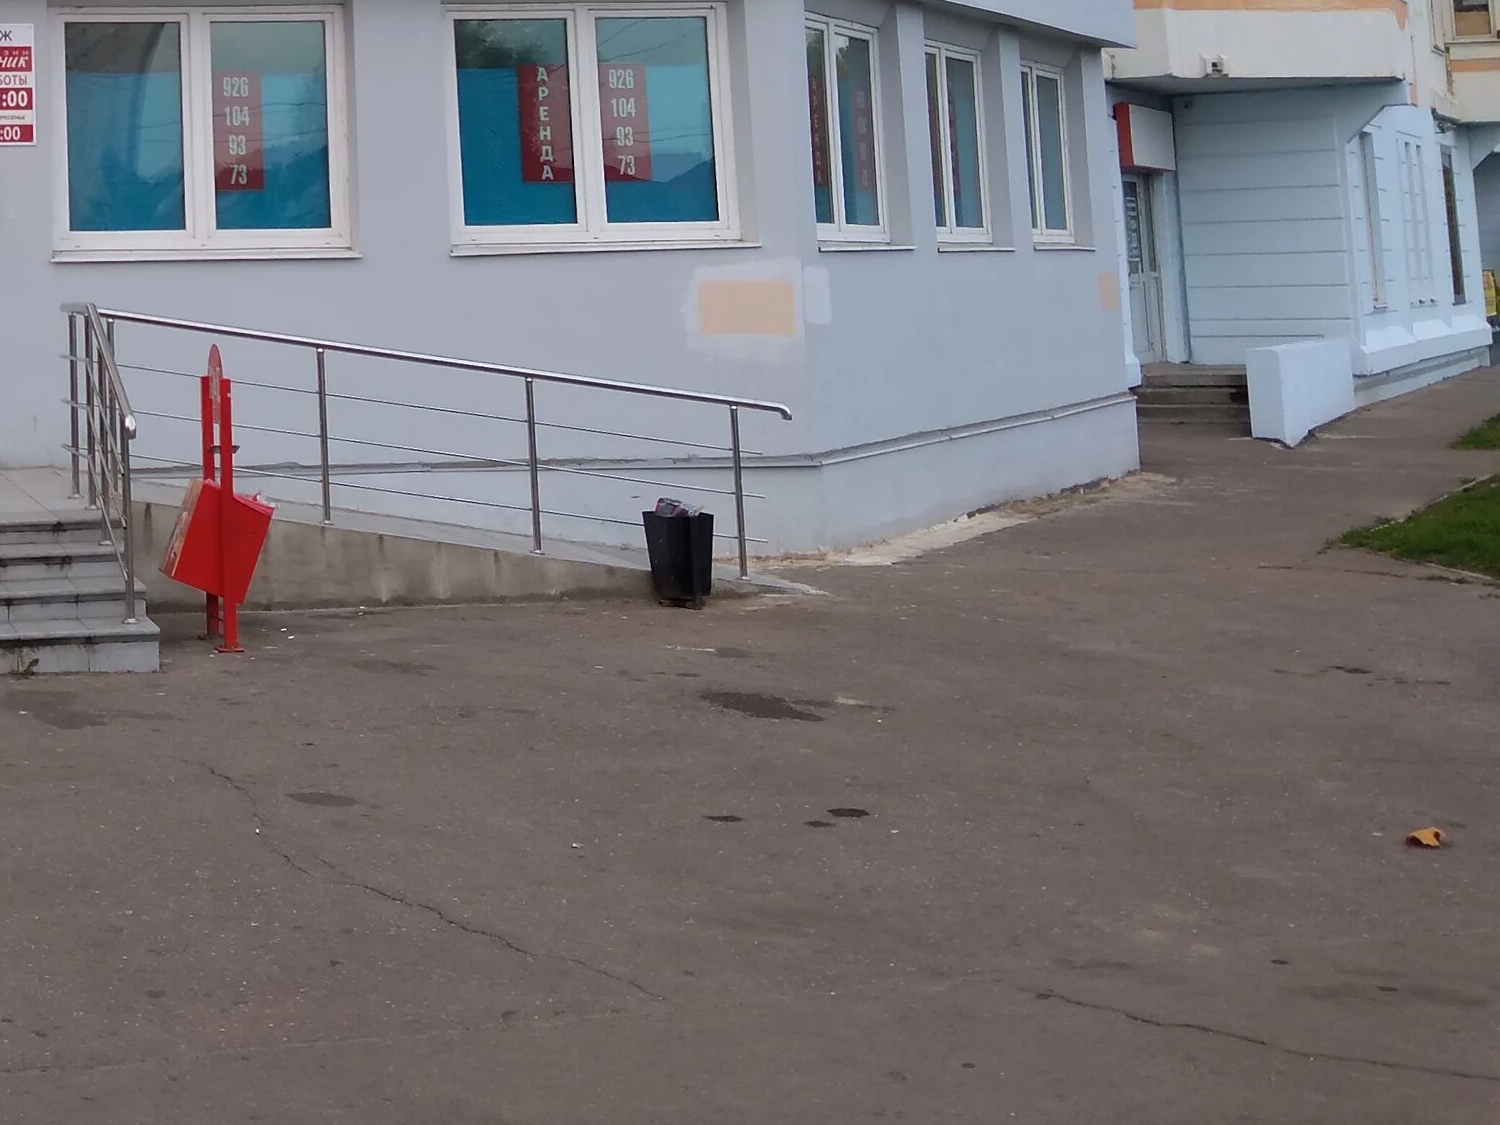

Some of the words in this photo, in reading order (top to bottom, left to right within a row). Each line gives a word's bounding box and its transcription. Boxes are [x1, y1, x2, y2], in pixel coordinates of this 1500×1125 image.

[223, 76, 249, 97] 926
[608, 69, 635, 89] 926
[224, 105, 250, 126] 104
[611, 97, 637, 118] 104
[228, 134, 247, 155] 93
[616, 126, 634, 147] 93
[229, 164, 248, 185] 73
[618, 155, 636, 176] 73
